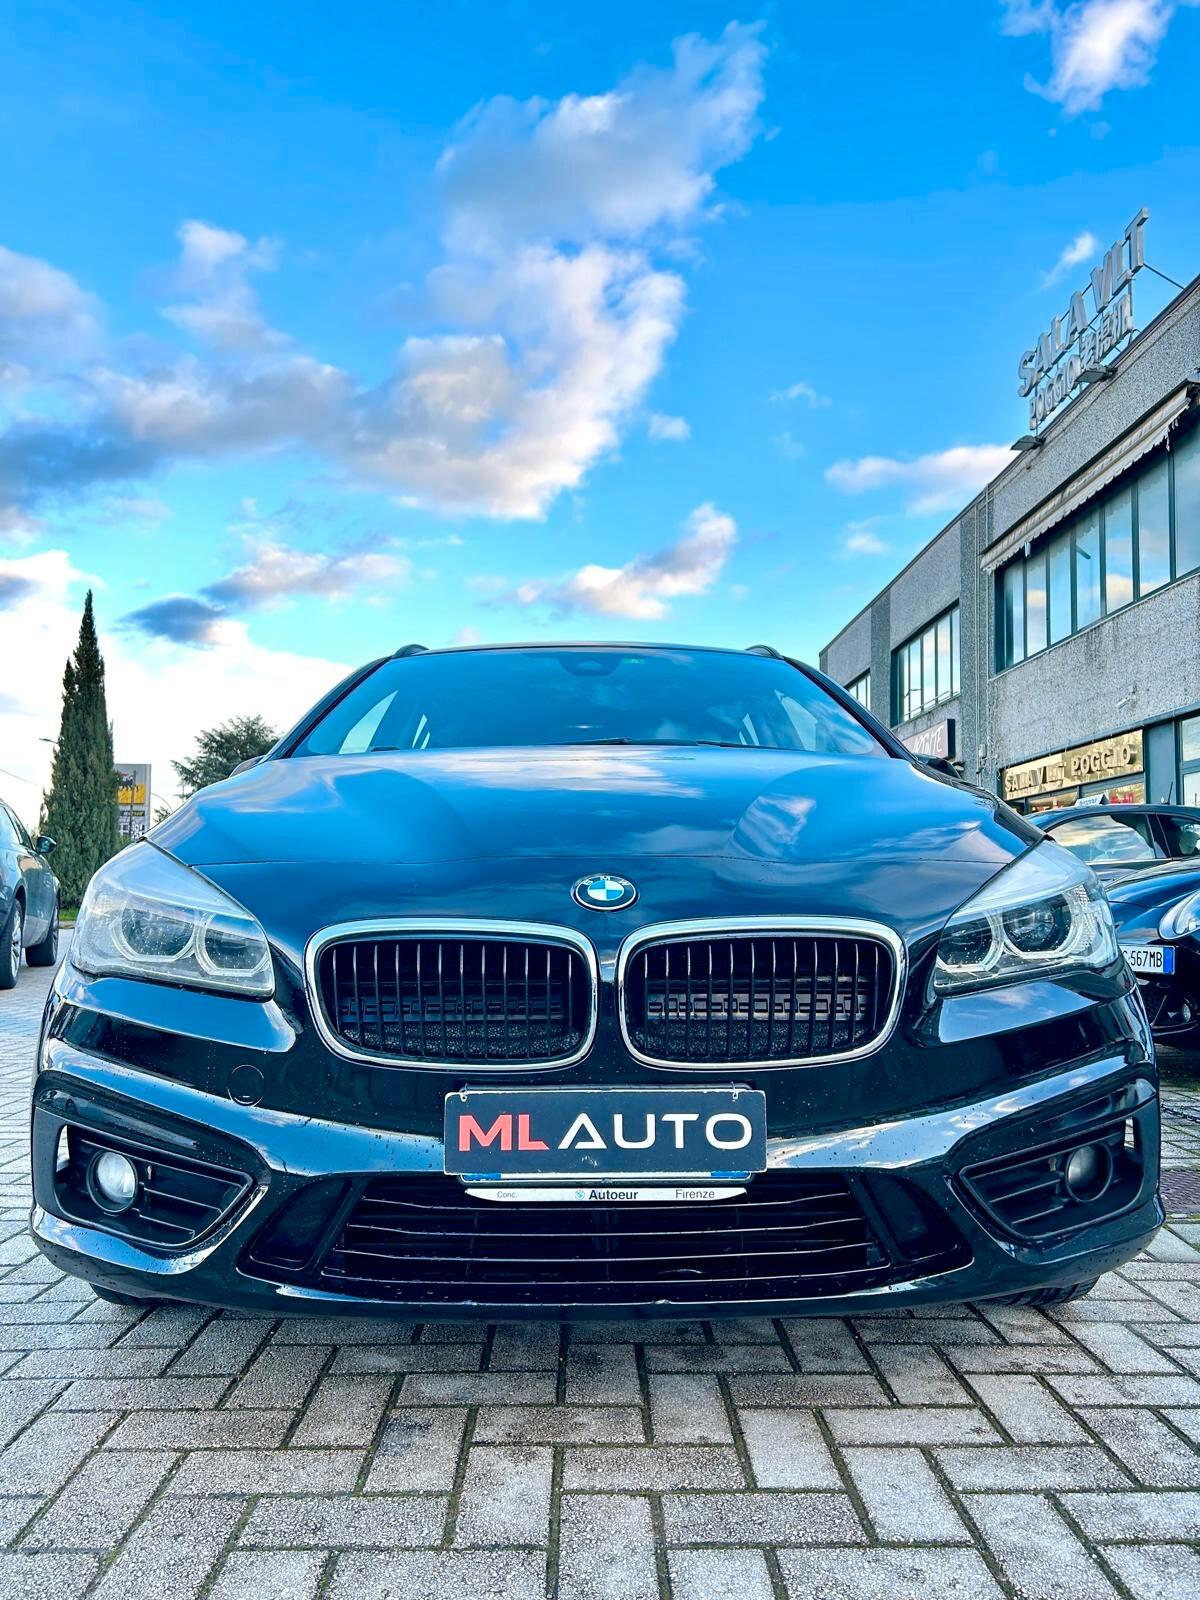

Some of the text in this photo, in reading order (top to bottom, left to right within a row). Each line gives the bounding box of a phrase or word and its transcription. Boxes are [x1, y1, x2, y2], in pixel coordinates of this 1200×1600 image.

[1018, 207, 1149, 397] SALA VLT
[1029, 354, 1081, 430] POGGIO
[1005, 769, 1039, 792] SALA
[1071, 744, 1135, 777] POGGIO
[458, 1112, 753, 1152] ML AUTO
[589, 1188, 639, 1201] Autoeur
[675, 1188, 716, 1200] Firenze
